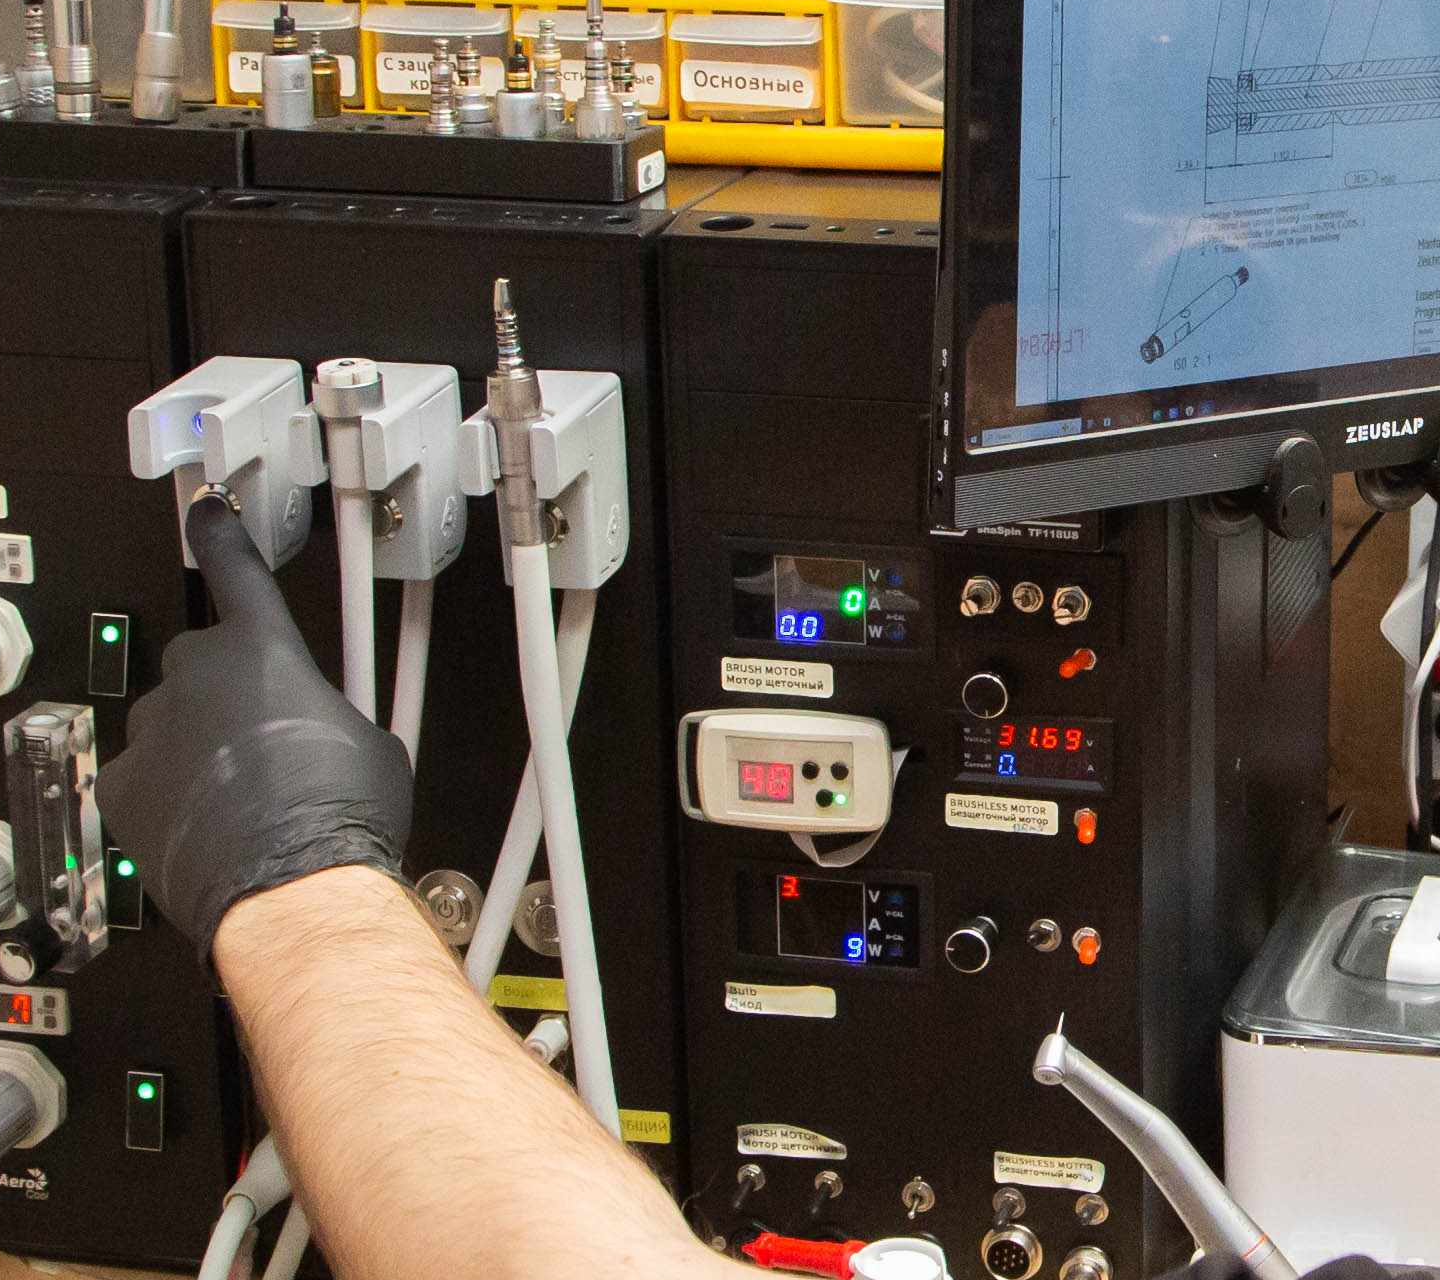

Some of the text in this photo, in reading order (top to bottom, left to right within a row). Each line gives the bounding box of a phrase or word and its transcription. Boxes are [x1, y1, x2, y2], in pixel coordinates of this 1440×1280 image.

[693, 69, 804, 93] Основные
[1346, 418, 1424, 445] ZEUSLAP
[725, 662, 805, 677] BRUSH MOTOR
[726, 674, 824, 690] Мотор щеточный
[950, 798, 1046, 815] BRUSHLESS MOTOR
